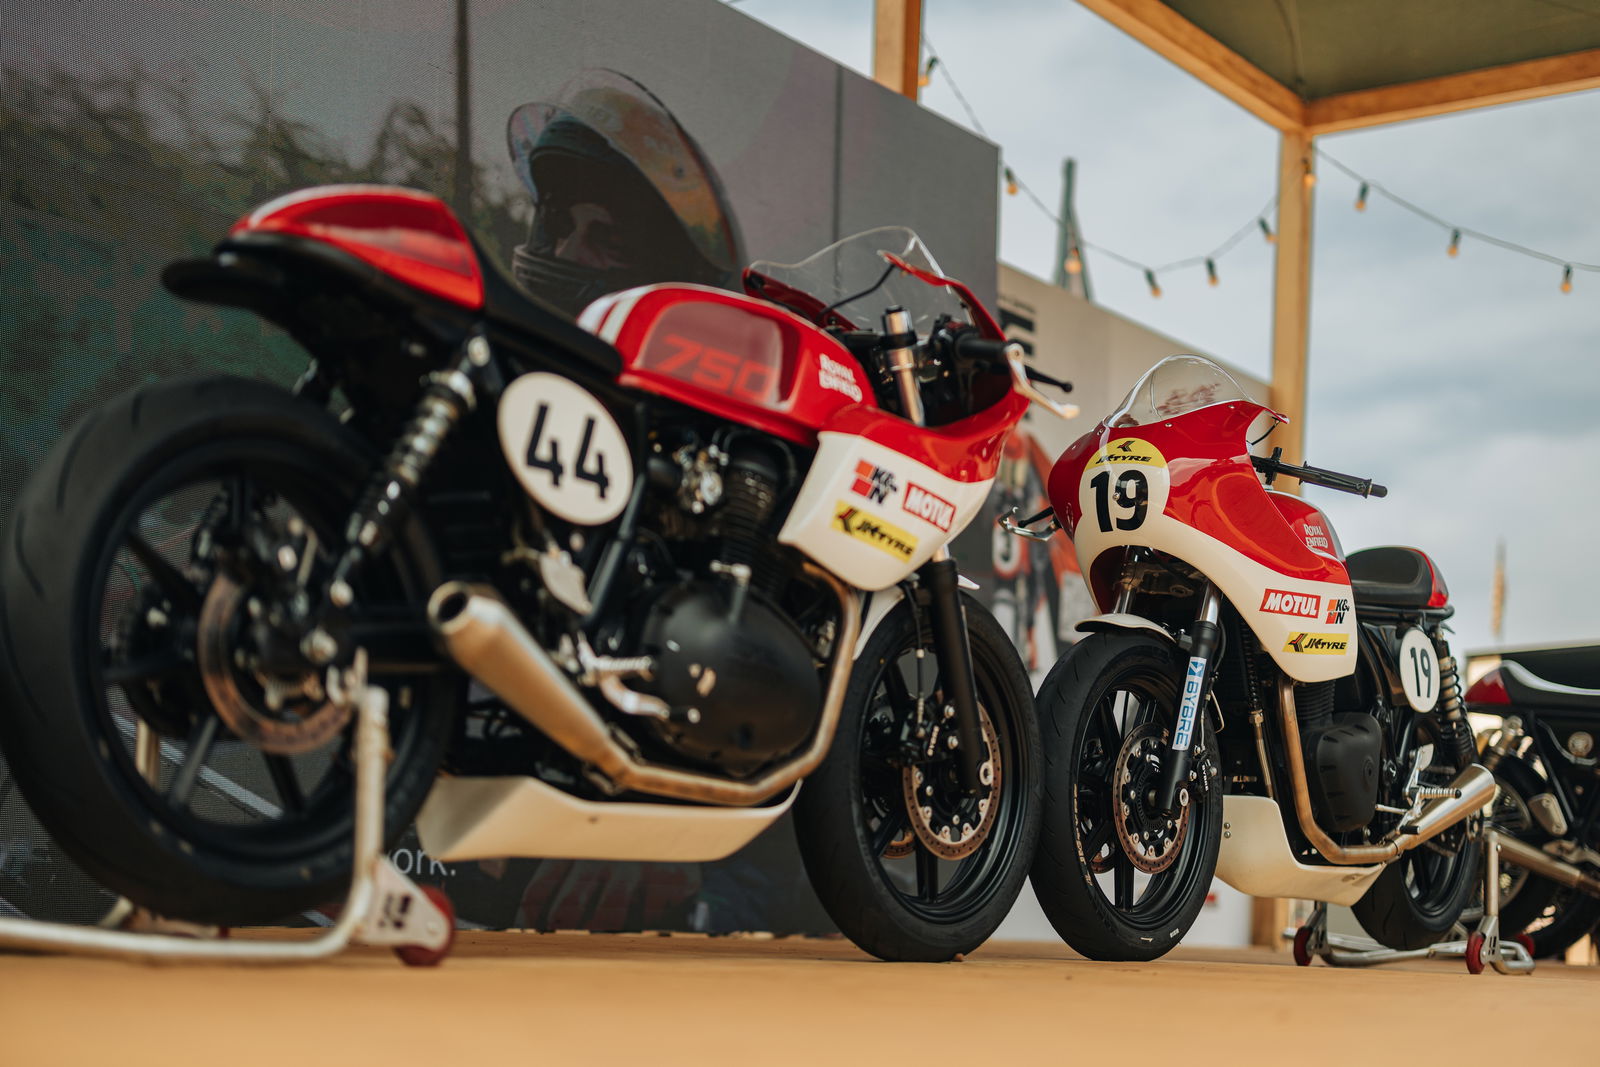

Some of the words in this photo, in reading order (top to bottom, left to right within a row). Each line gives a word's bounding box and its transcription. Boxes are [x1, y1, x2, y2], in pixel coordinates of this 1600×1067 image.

[656, 333, 774, 402] 750
[526, 403, 610, 500] 44
[1090, 469, 1149, 533] 19
[1303, 523, 1324, 536] ROYAL
[1305, 536, 1329, 549] ENFIELD
[1263, 591, 1318, 616] MOTUL
[1410, 646, 1432, 698] 19
[1175, 680, 1199, 747] BYBRE
[388, 848, 456, 876] ork.
